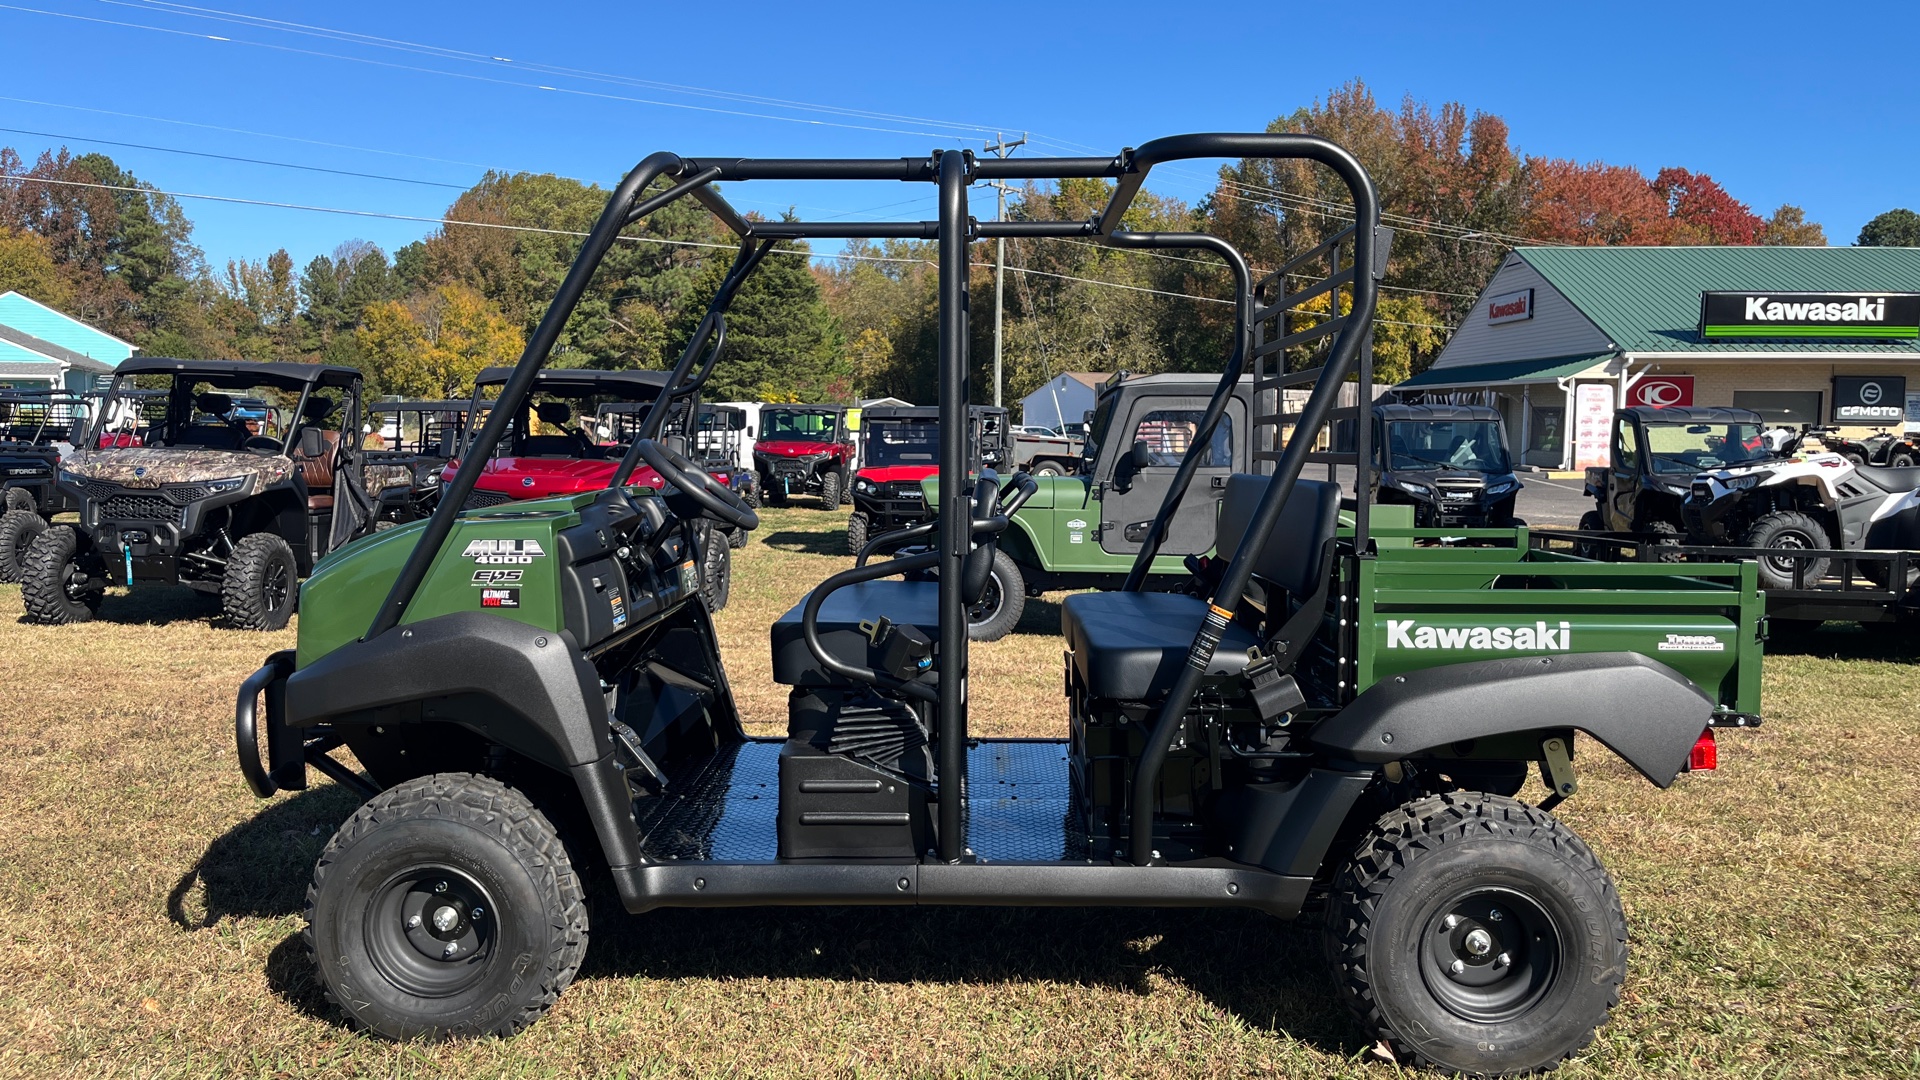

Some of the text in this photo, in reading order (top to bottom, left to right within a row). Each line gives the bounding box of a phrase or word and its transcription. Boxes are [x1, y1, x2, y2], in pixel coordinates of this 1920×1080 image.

[1489, 296, 1526, 319] Kawasaki
[1745, 297, 1885, 321] Kawasaki
[1841, 406, 1899, 417] CFMOTO
[462, 540, 546, 556] MULE
[474, 556, 532, 564] 4000
[471, 570, 524, 584] EPS
[482, 590, 510, 599] ULTIMATE
[482, 598, 501, 606] CYCLE
[1386, 620, 1571, 650] Kawasaki
